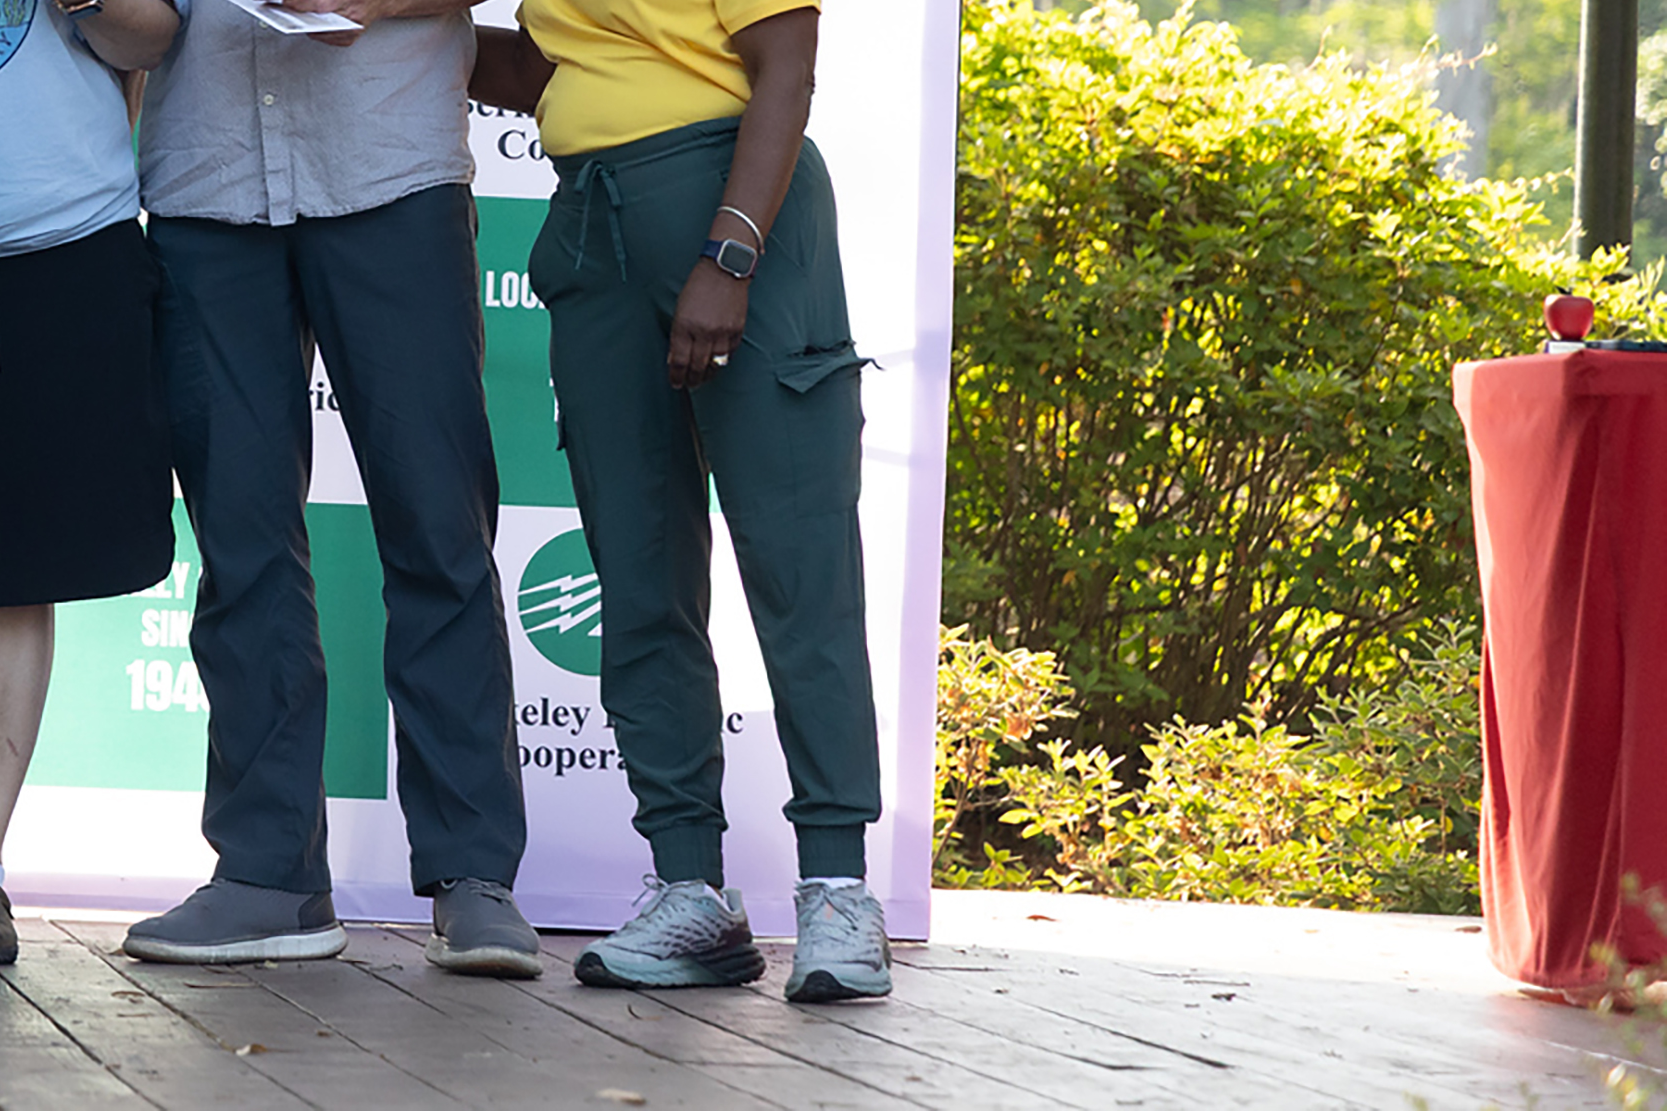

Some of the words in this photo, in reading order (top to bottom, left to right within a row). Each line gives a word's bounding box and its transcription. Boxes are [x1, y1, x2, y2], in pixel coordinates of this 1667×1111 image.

[485, 270, 546, 310] LOC
[141, 608, 194, 648] SIN
[125, 659, 211, 712] 194
[515, 697, 591, 736] eley
